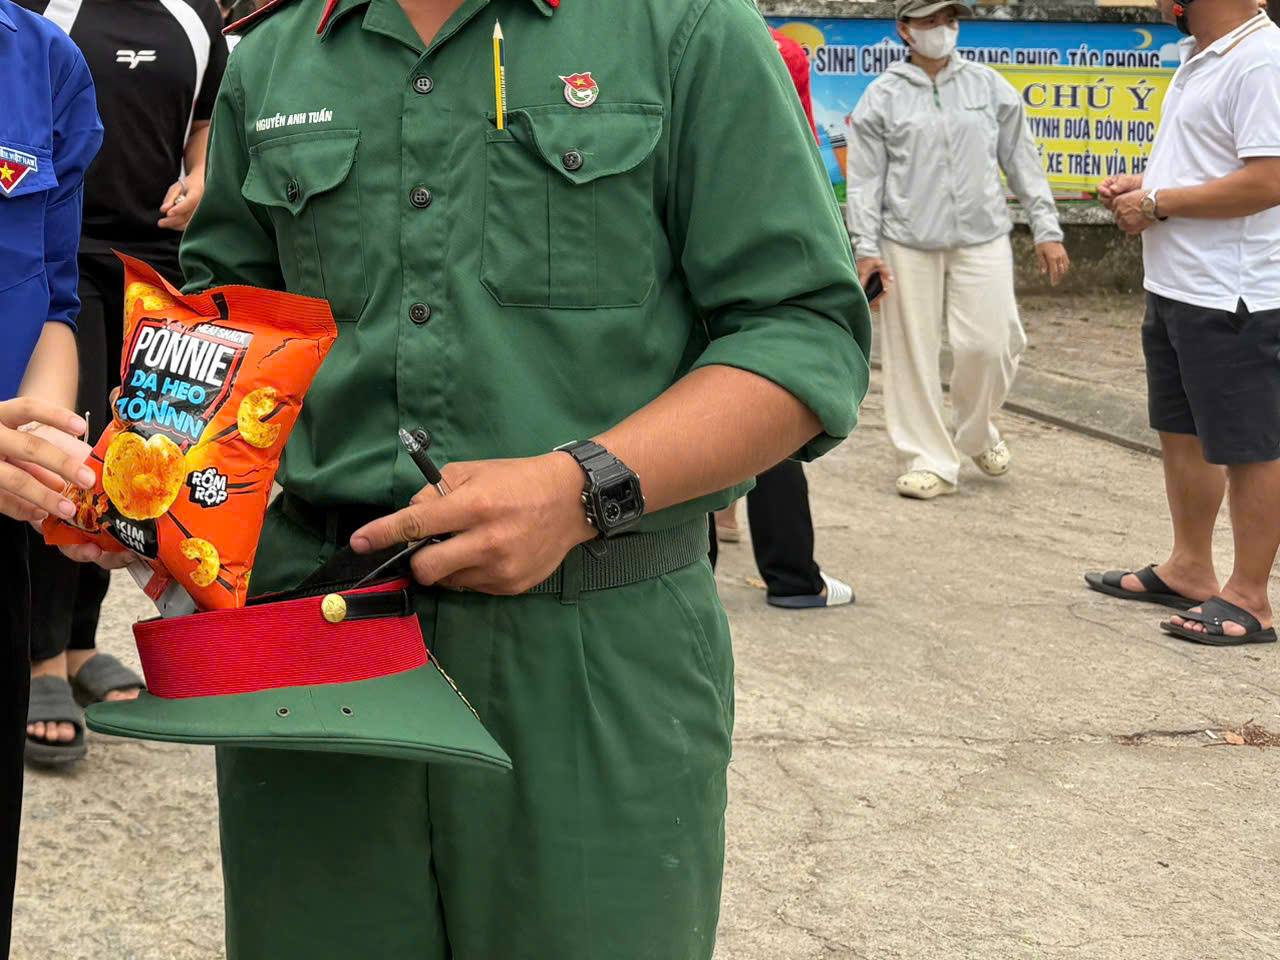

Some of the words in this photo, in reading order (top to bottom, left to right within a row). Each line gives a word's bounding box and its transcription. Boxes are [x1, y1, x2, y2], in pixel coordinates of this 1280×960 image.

[816, 47, 856, 74] SINH
[1022, 77, 1115, 109] CHÚ
[1127, 79, 1155, 111] Ý
[287, 112, 307, 126] ANH
[1064, 118, 1091, 140] ĐƯA
[1095, 115, 1123, 141] ĐÓN
[1127, 120, 1155, 147] HỌC
[1046, 152, 1063, 174] XE
[1067, 148, 1101, 175] TRÊN
[1105, 147, 1127, 175] VỈA
[130, 326, 236, 387] PONNIE
[130, 369, 158, 392] DA
[161, 377, 206, 405] HEO
[191, 468, 227, 491] RÔM
[195, 485, 228, 506] RỘP
[115, 519, 145, 545] KIM
[120, 532, 145, 553] CHI
